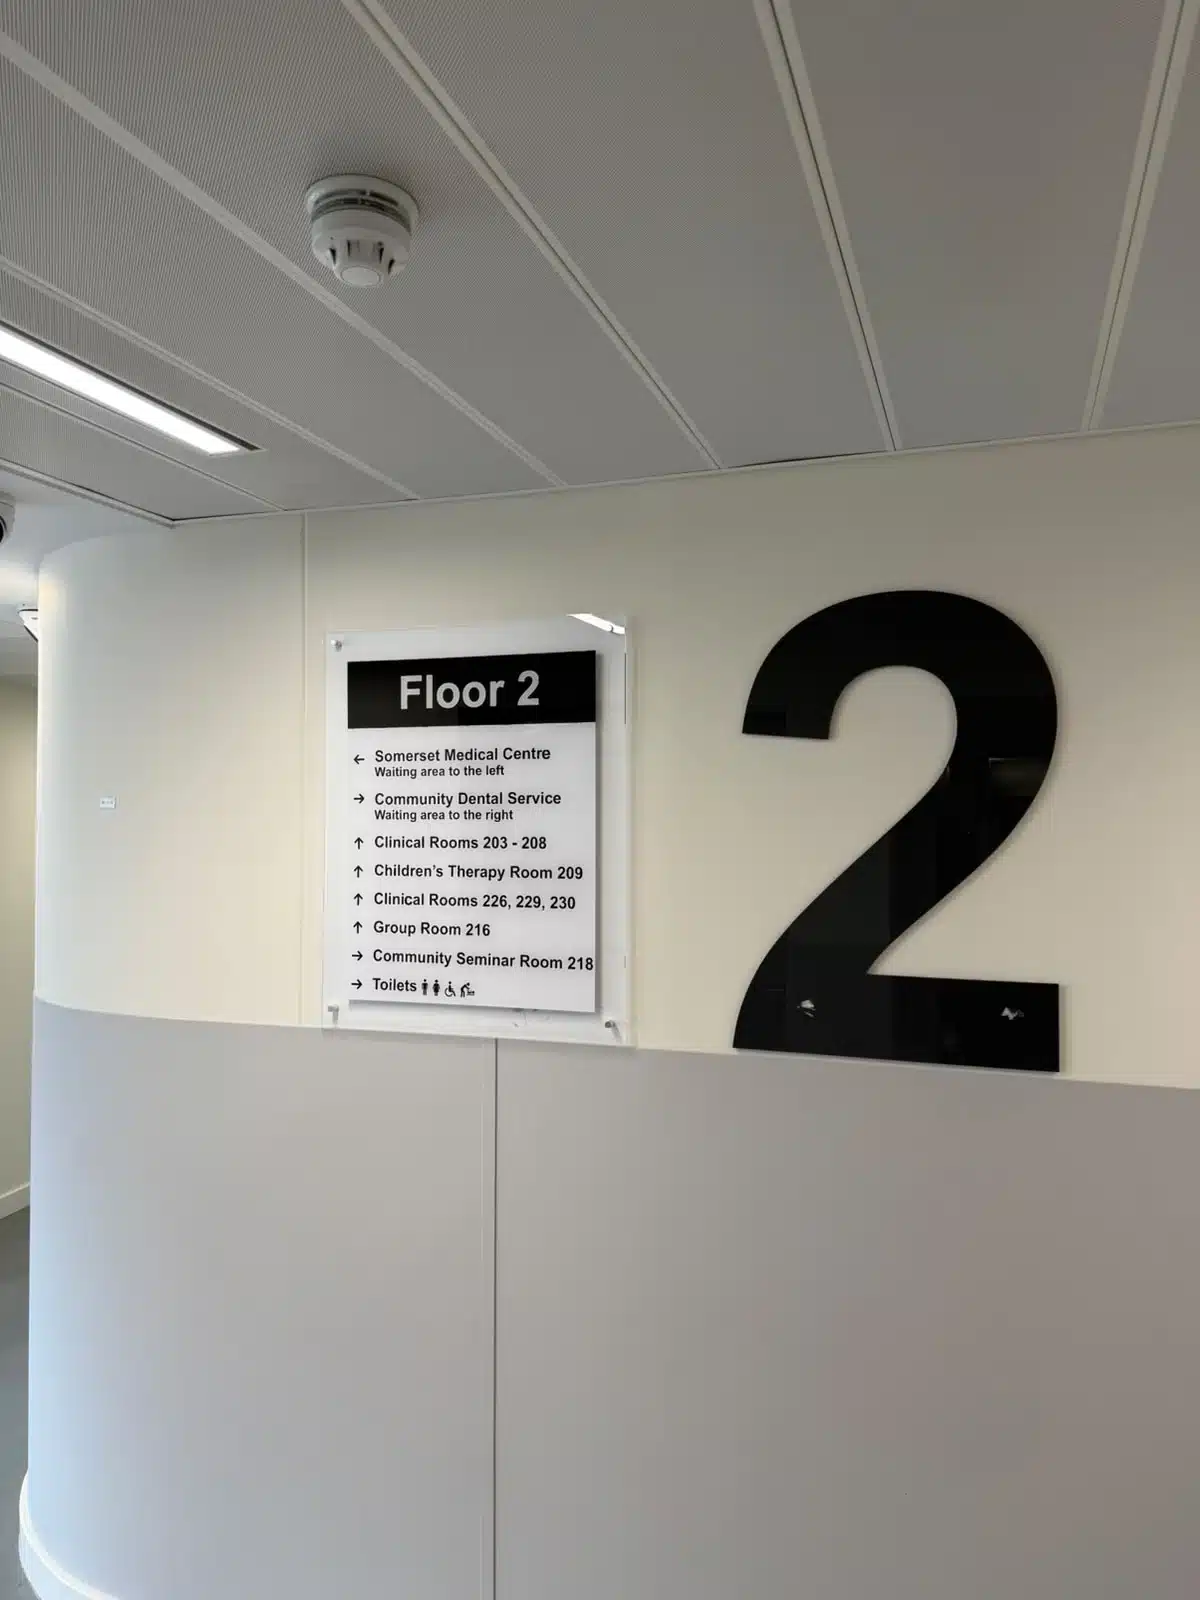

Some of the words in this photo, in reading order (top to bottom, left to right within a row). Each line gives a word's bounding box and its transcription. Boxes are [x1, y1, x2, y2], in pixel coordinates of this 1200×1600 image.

[401, 675, 504, 709] Floor
[518, 671, 539, 705] 2
[376, 750, 440, 762] Somerset
[445, 748, 497, 761] Medical
[503, 747, 550, 760] Centre
[375, 767, 416, 779] Waiting
[449, 767, 460, 776] to
[464, 766, 482, 776] the
[486, 765, 504, 775] left
[375, 793, 453, 808] Community
[459, 792, 502, 804] Dental
[508, 792, 561, 804] Service
[375, 810, 416, 822] Waiting
[449, 811, 460, 819] to
[464, 810, 481, 819] the
[486, 809, 513, 822] right
[733, 590, 1059, 1072] 2
[375, 836, 424, 848] Clinical
[430, 836, 478, 848] Rooms
[483, 836, 507, 849] 203
[522, 837, 546, 849] 208
[448, 865, 505, 881] Therapy
[510, 866, 552, 879] Room
[558, 867, 583, 879] 209
[375, 893, 424, 905] Clinical
[430, 894, 477, 907] Rooms
[483, 895, 511, 909] 226,
[516, 895, 545, 910] 229,
[550, 896, 575, 909] 230
[374, 921, 416, 936] Group
[421, 922, 460, 935] Room
[466, 923, 490, 936] 216
[374, 949, 451, 967] Community
[457, 952, 515, 967] Seminar
[520, 955, 562, 969] Room
[568, 957, 593, 970] 218
[373, 978, 416, 991] Toilets
